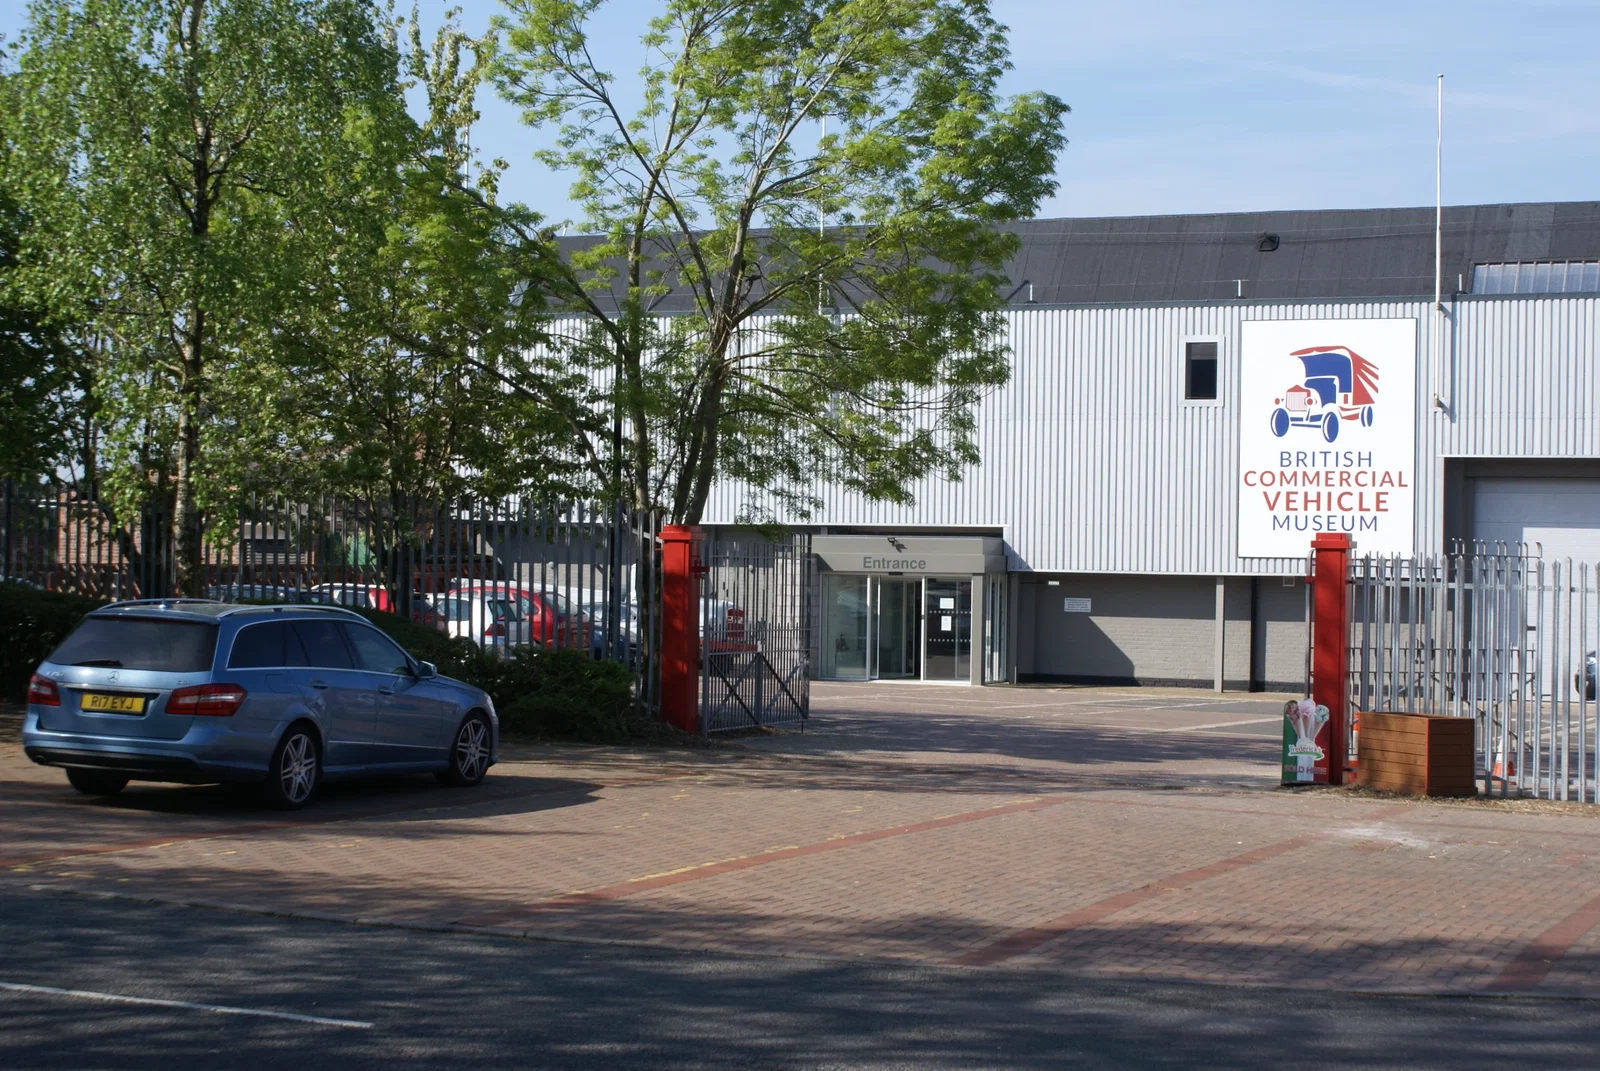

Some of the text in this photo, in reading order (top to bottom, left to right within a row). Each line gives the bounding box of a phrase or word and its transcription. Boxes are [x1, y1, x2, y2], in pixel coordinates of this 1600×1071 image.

[1280, 451, 1371, 467] BRITISH
[1244, 470, 1408, 487] COMMERCIAL
[1263, 491, 1389, 512] VEHICLE
[1273, 515, 1377, 531] MUSEUM
[863, 556, 926, 569] Entrance
[91, 696, 134, 709] R17 EYJ
